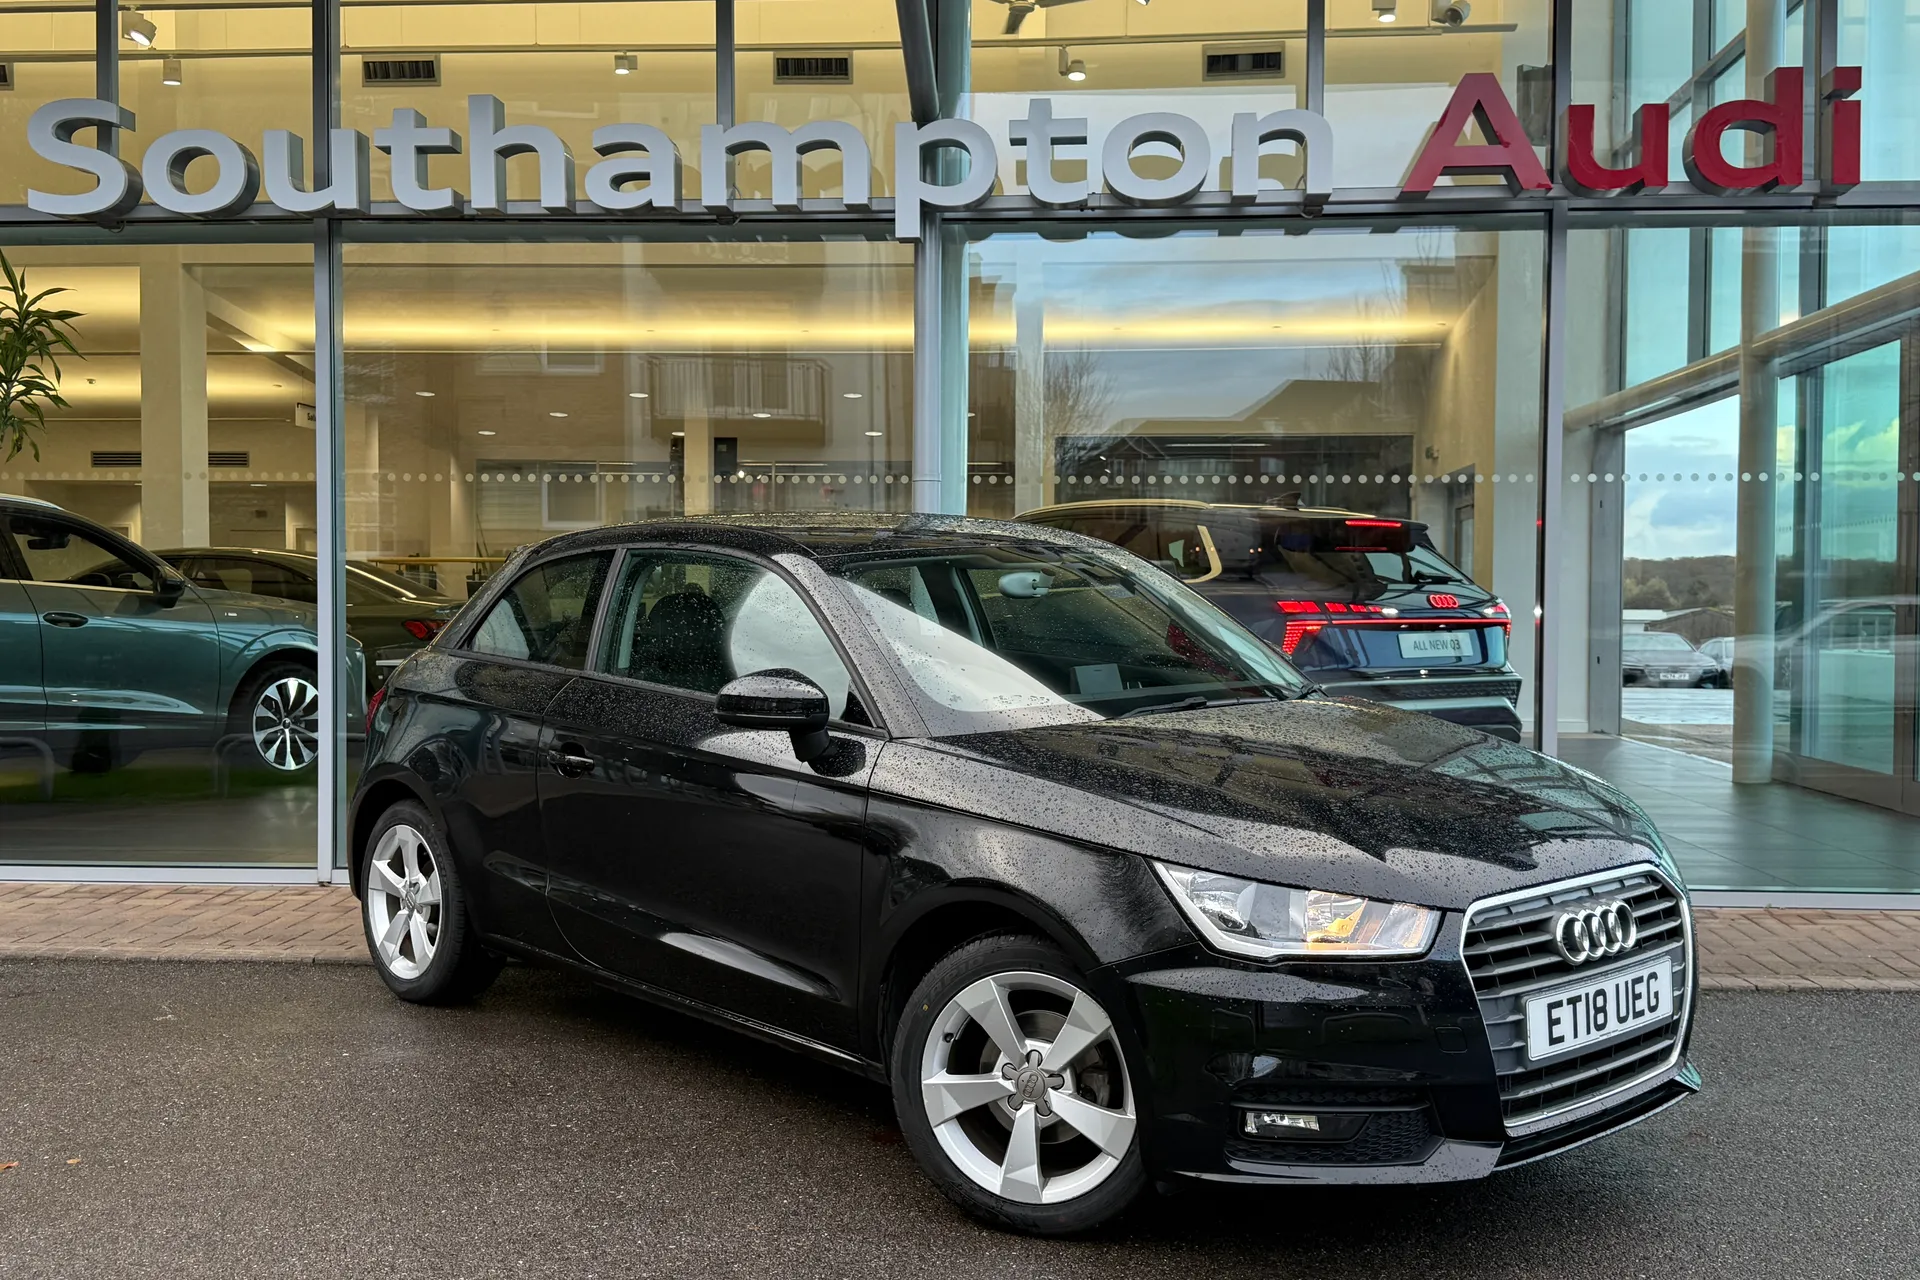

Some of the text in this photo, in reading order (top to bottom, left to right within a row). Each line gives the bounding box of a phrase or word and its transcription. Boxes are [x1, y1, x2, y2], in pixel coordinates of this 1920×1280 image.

[26, 66, 1862, 242] Southampton Audi
[1413, 639, 1461, 650] ALL NEW Q3
[1547, 971, 1659, 1046] ET18 UEG
